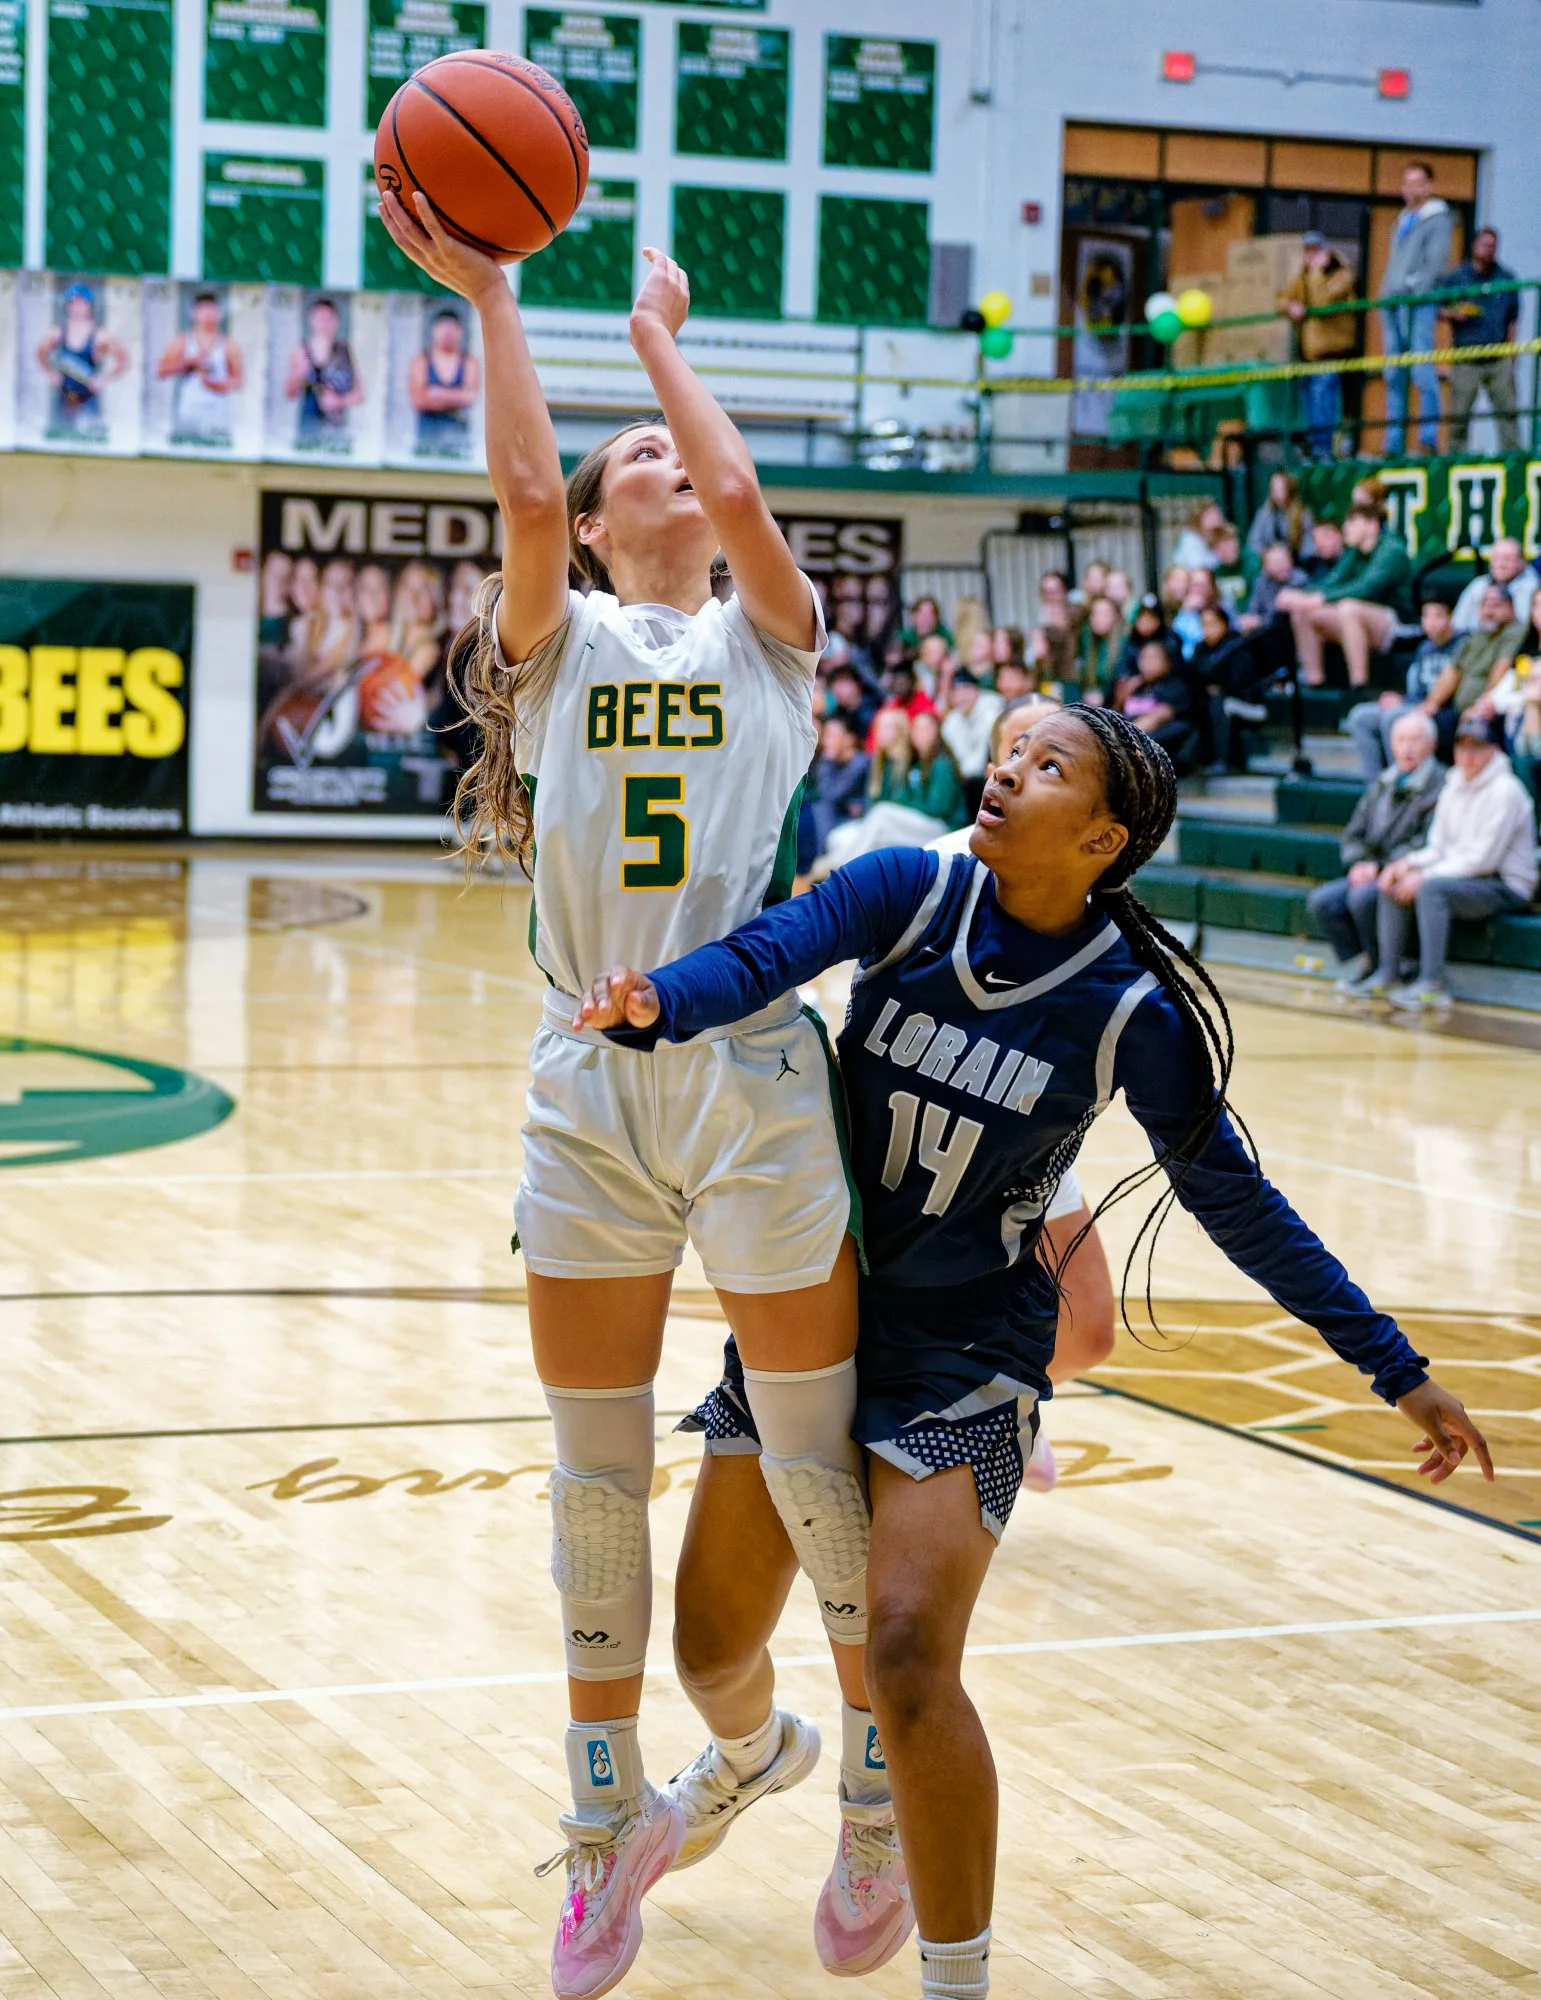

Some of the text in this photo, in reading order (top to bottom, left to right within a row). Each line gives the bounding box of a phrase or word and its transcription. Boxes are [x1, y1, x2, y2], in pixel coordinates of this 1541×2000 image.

[0, 644, 186, 759] BEES
[586, 681, 726, 752] BEES
[620, 773, 690, 892] 5
[863, 997, 1054, 1116] LORAIN
[881, 1090, 985, 1218] 14
